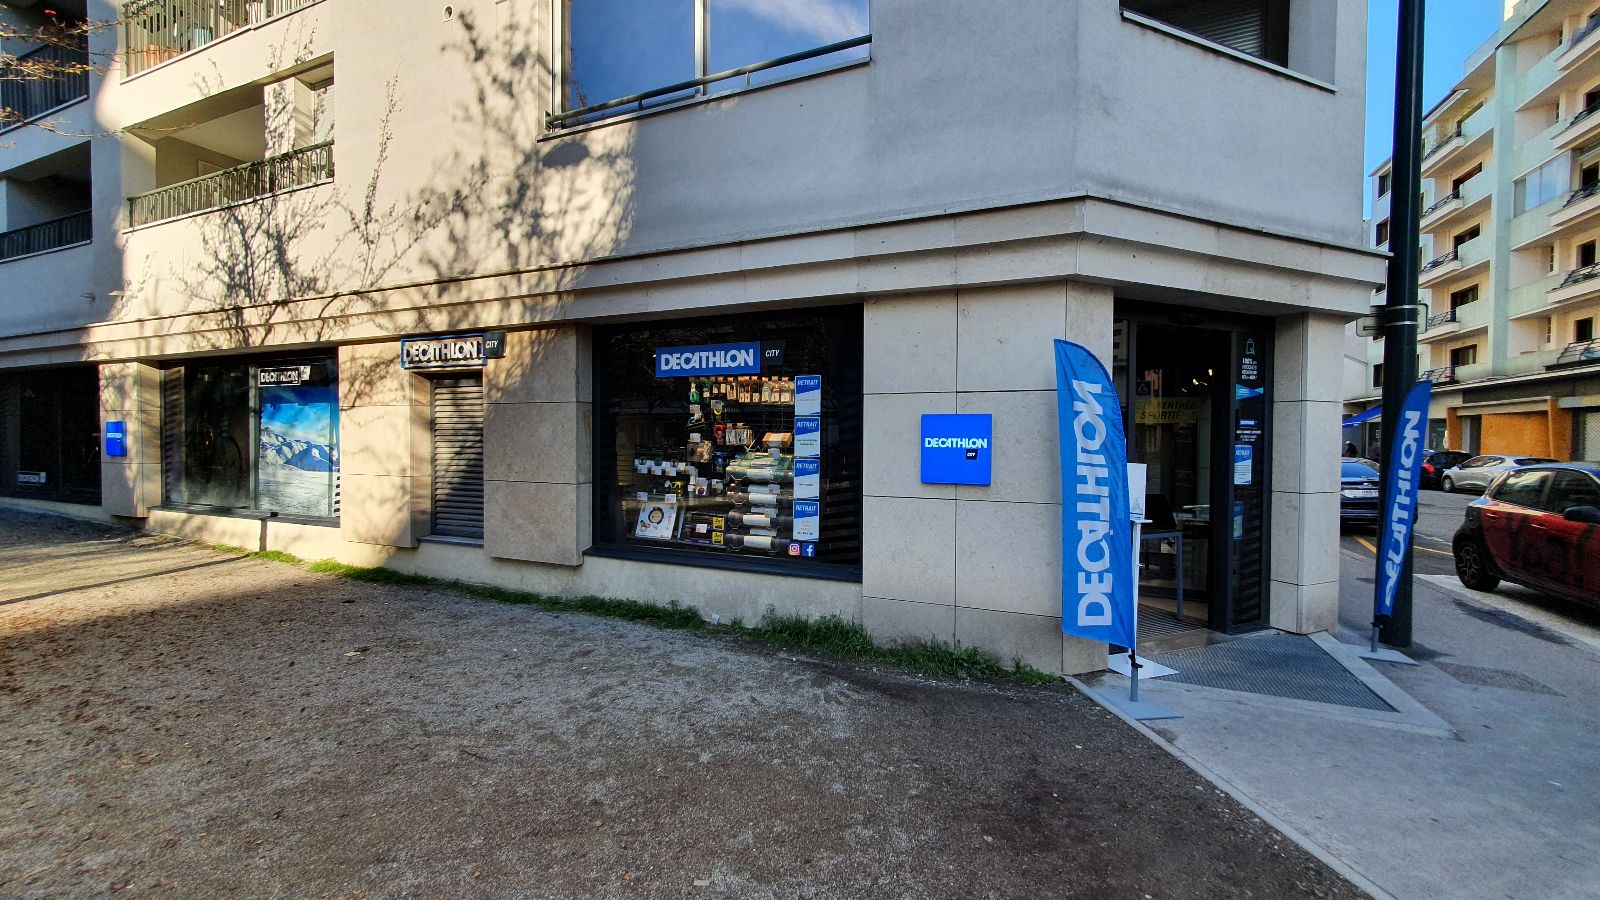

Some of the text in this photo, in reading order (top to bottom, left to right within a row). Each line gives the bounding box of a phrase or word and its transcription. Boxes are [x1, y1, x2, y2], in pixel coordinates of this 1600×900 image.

[403, 340, 499, 361] DECATHLON CITY
[661, 349, 780, 371] DECATHLON CITY
[924, 437, 988, 449] DECATHLON
[796, 462, 818, 470] RETRAIT
[795, 504, 817, 512] RETRAIT
